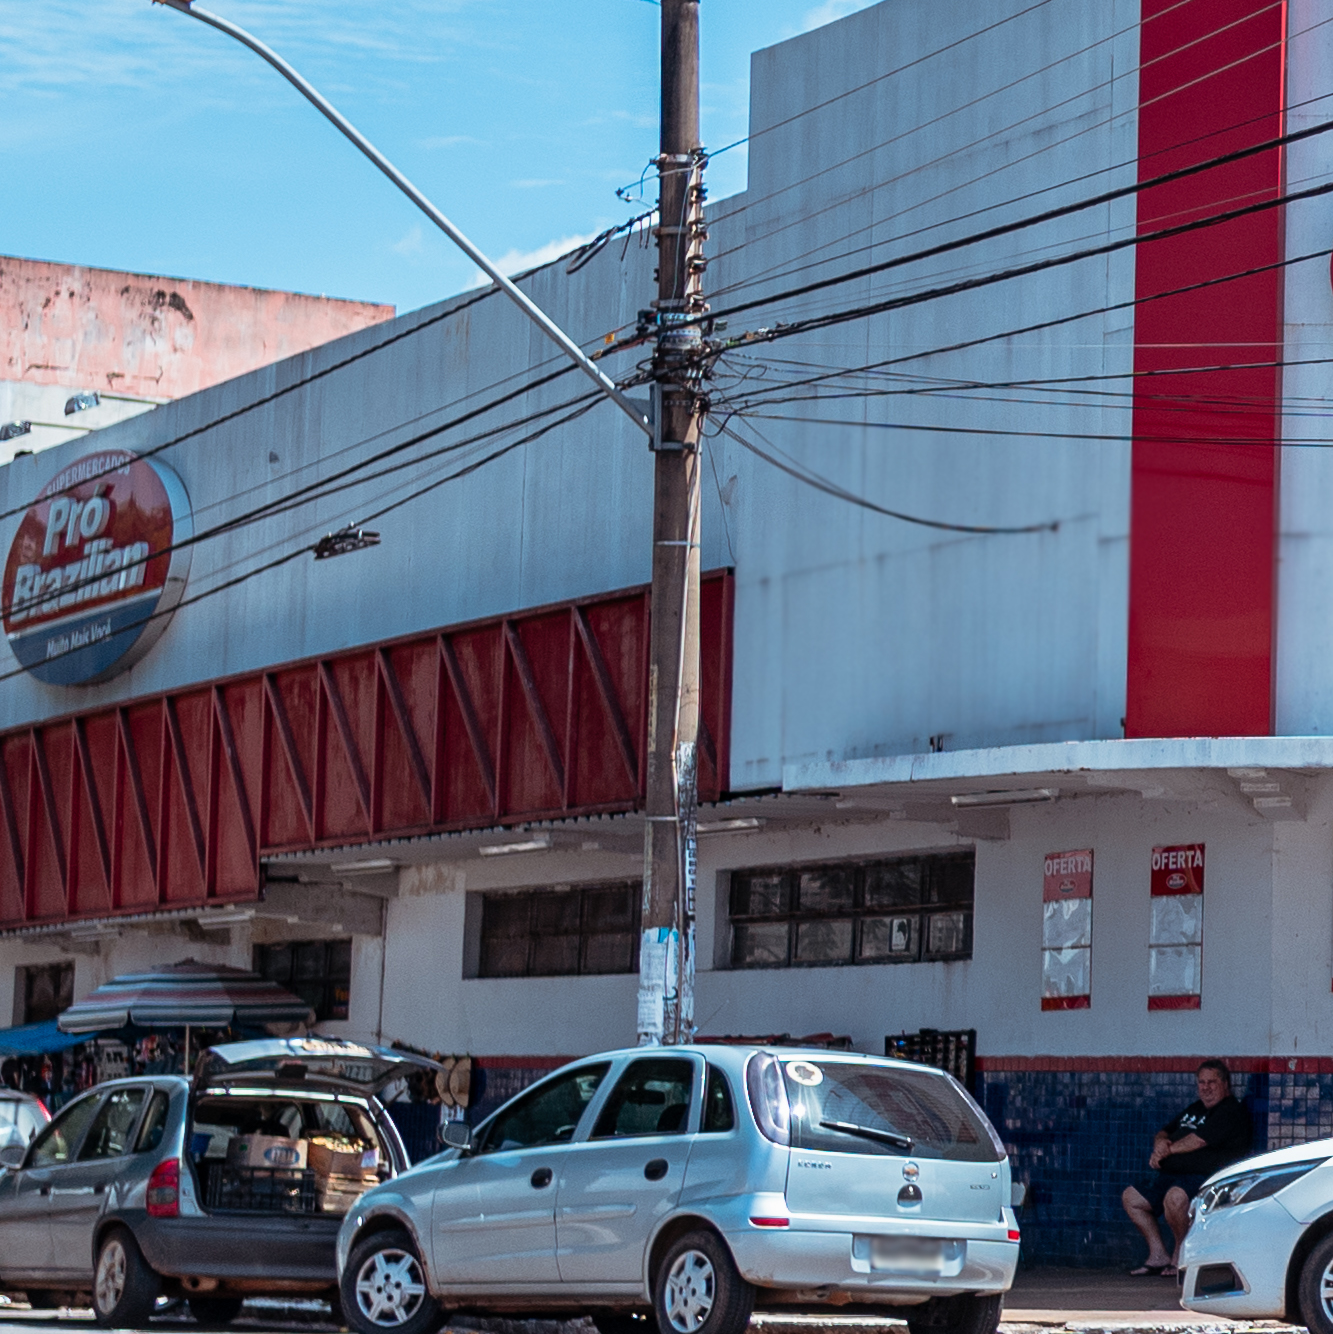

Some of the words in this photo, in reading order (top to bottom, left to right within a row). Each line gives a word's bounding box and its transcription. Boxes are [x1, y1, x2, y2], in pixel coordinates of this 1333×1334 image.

[47, 453, 130, 495] SUPERMERCADOS
[43, 483, 114, 556] Pró
[10, 535, 148, 623] Brazilian
[1044, 856, 1092, 877] OFERTA
[1152, 850, 1203, 871] OFERTA
